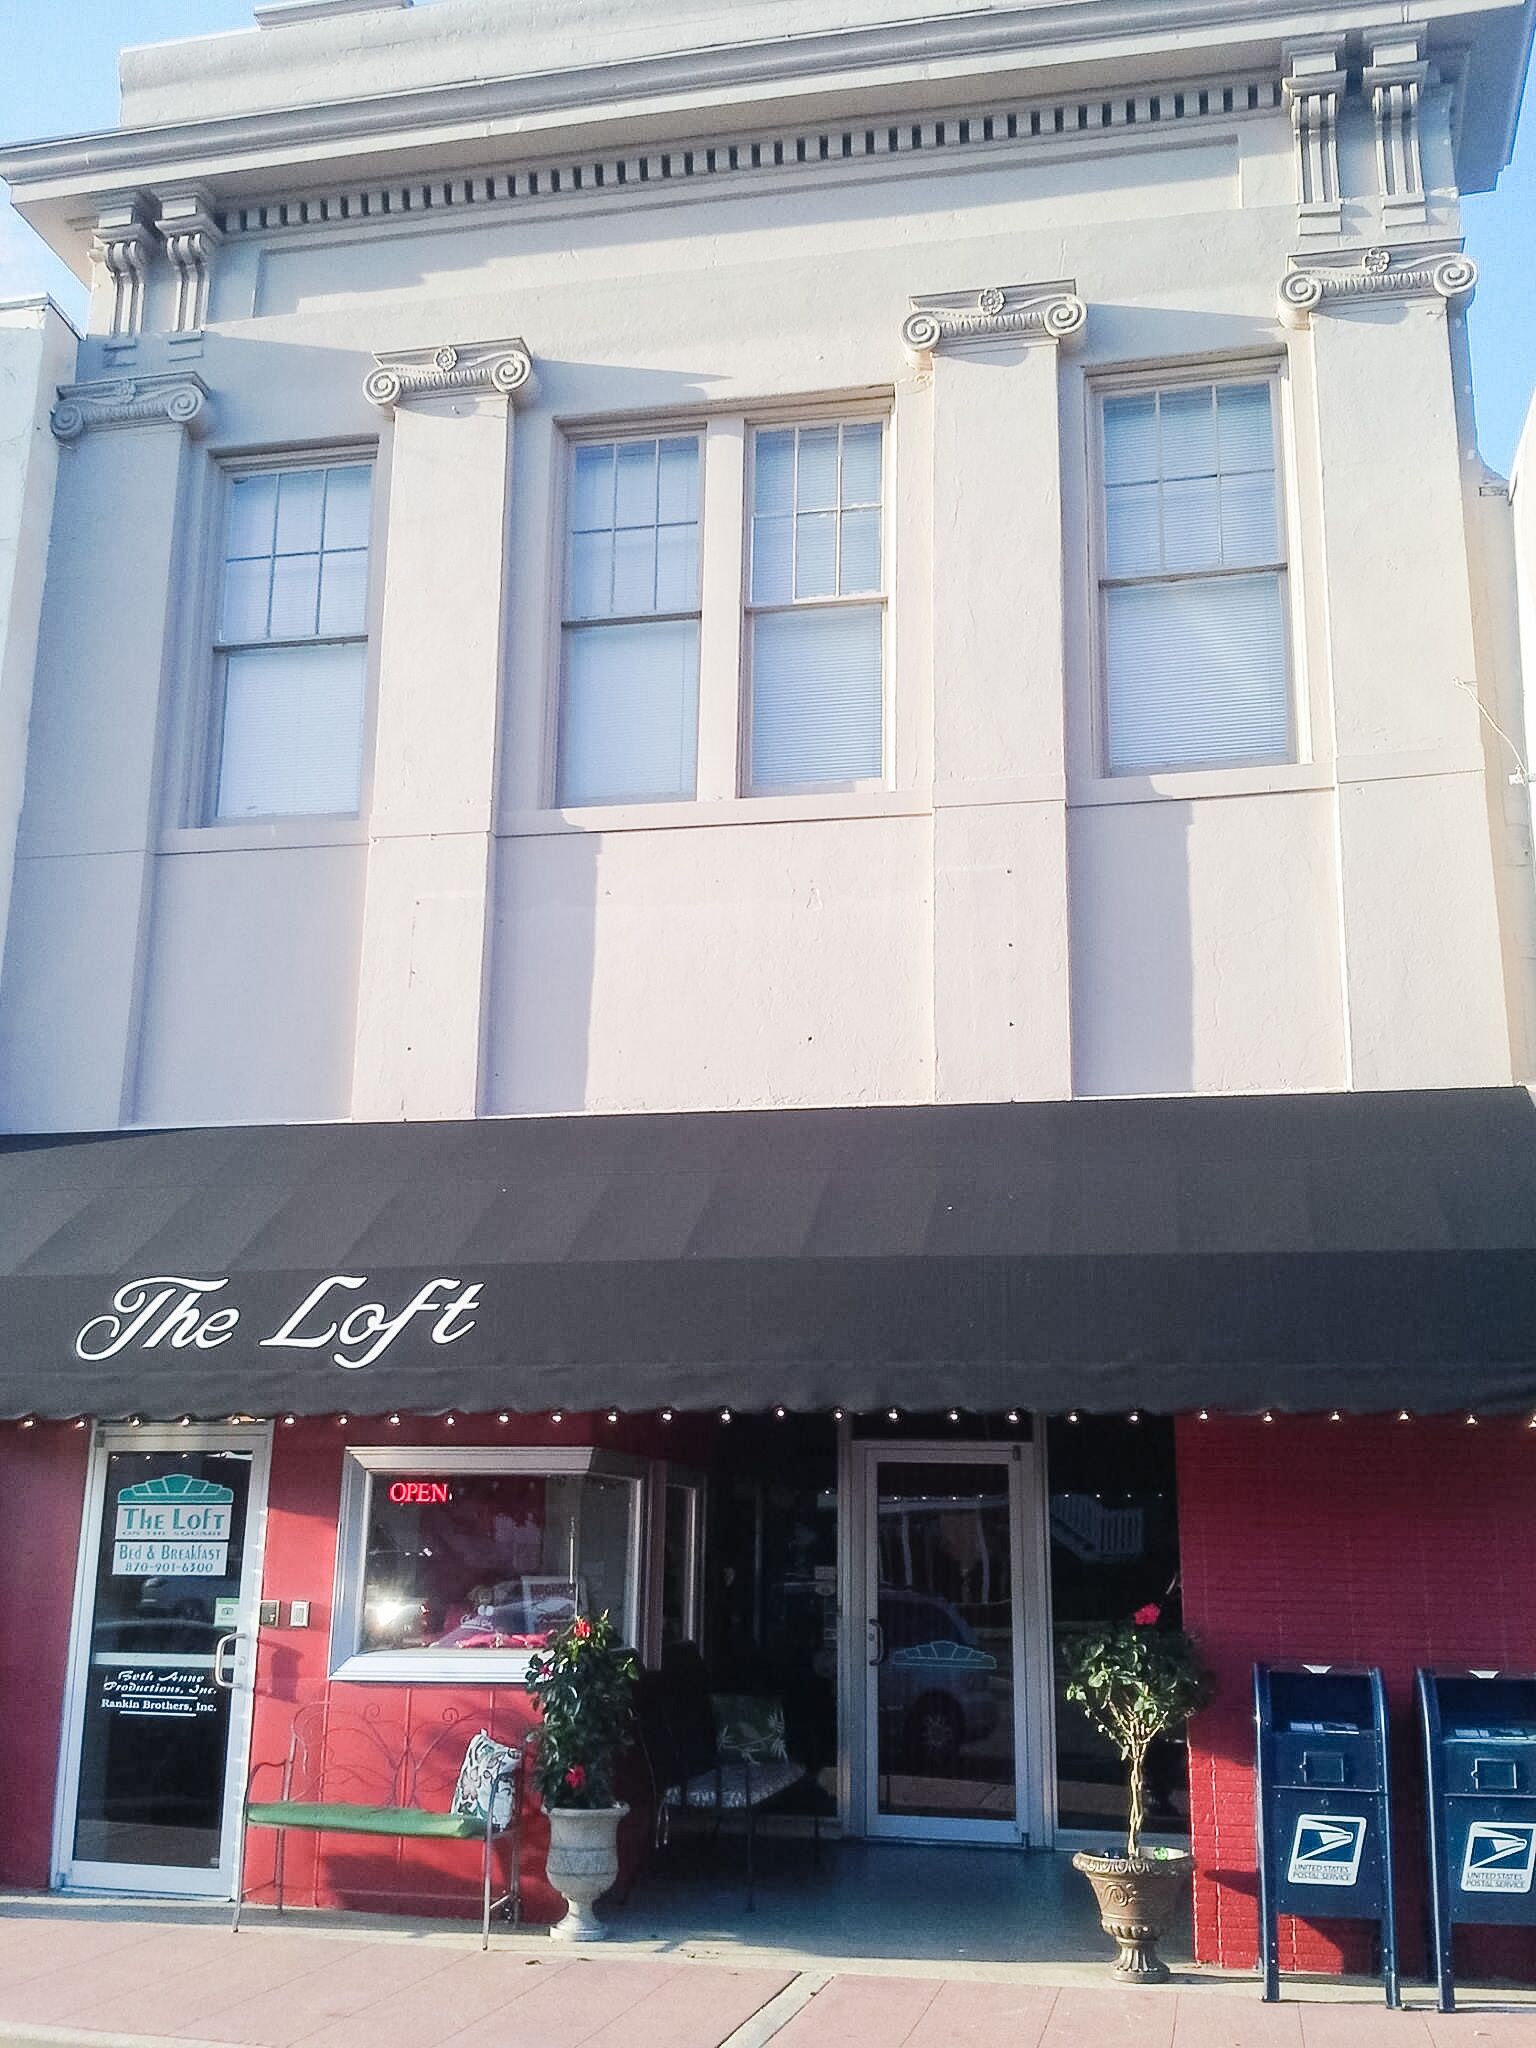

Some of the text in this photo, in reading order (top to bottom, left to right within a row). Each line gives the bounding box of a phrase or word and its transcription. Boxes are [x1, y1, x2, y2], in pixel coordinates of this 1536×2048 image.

[75, 1275, 485, 1369] The Loft
[389, 1482, 448, 1504] OPEN
[146, 1544, 155, 1560] &
[118, 1670, 205, 1683] Beth Anne
[103, 1681, 217, 1695] Productions, Inc.
[101, 1698, 217, 1712] Rankin Brothers, Inc.
[1294, 1863, 1350, 1873] UNITED STATES
[1292, 1871, 1351, 1882] POSTAL SERVICE
[1467, 1871, 1524, 1881] UNITED STATES
[1465, 1879, 1525, 1889] POSTAL SERVICE
